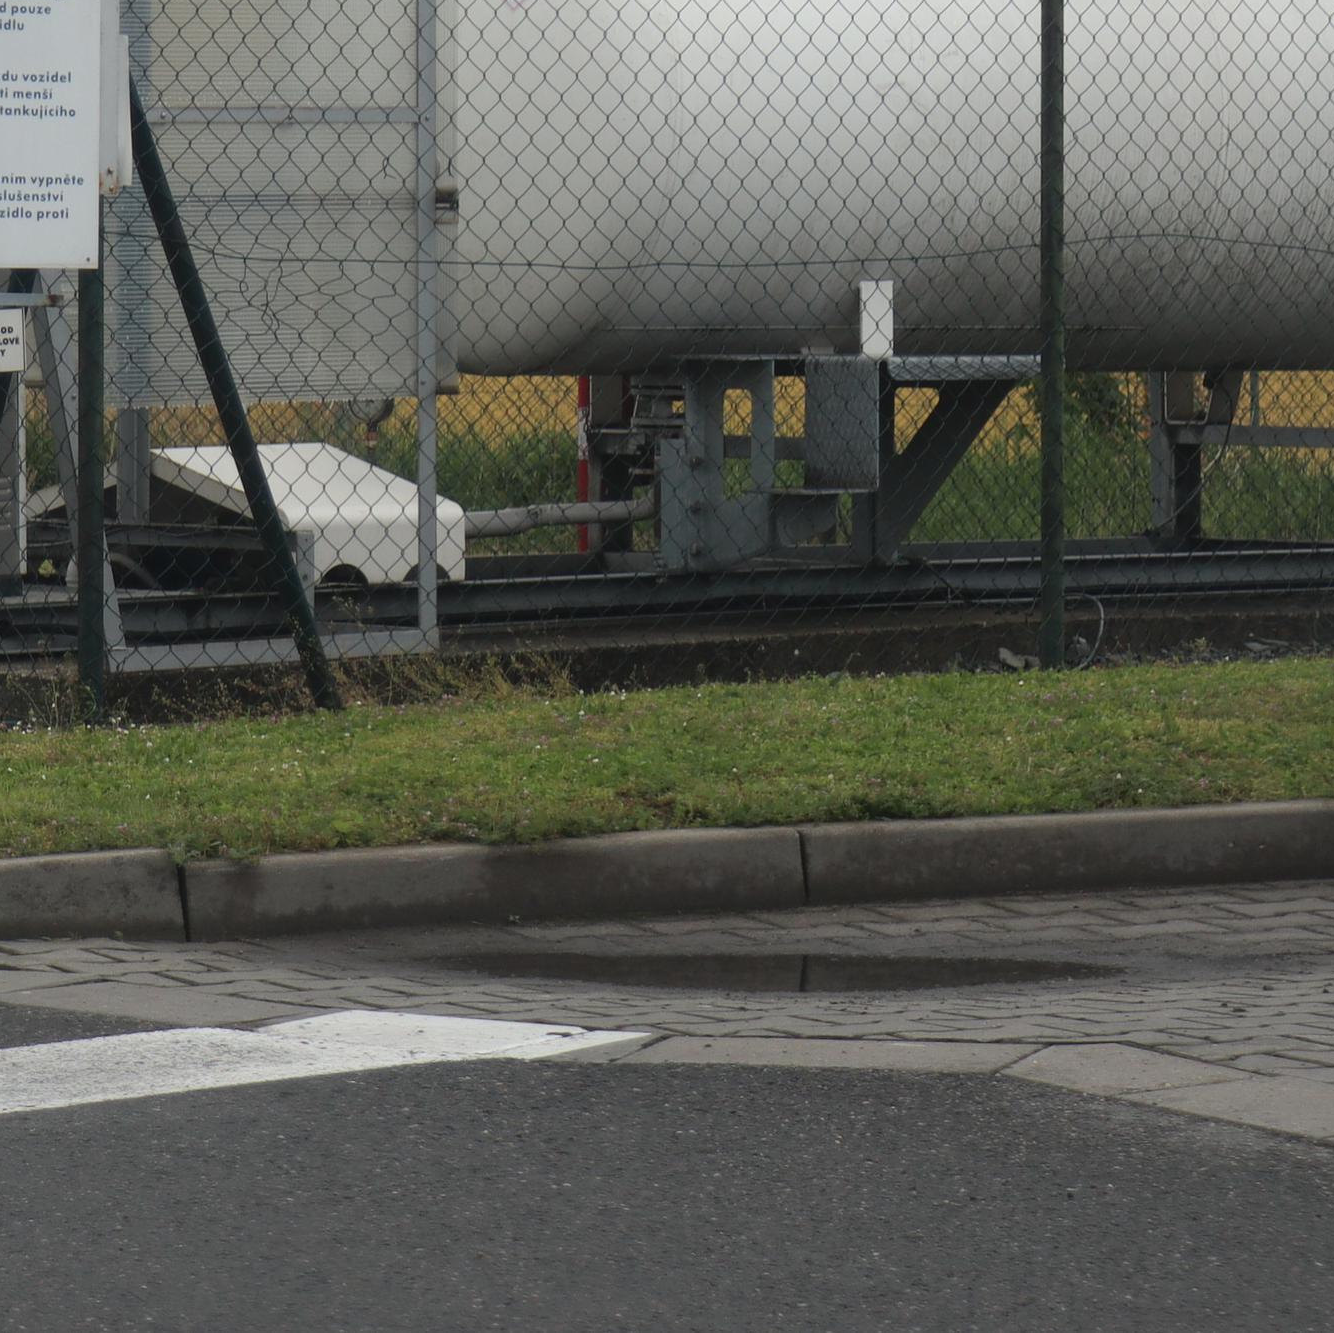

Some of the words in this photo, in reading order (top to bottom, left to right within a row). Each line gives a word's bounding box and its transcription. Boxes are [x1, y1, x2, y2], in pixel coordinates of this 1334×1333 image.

[11, 3, 52, 16] pouze
[22, 71, 72, 83] vozidel
[13, 89, 53, 100] menší
[0, 105, 76, 119] tankujícího
[30, 174, 85, 187] vypněte
[36, 208, 69, 222] proti
